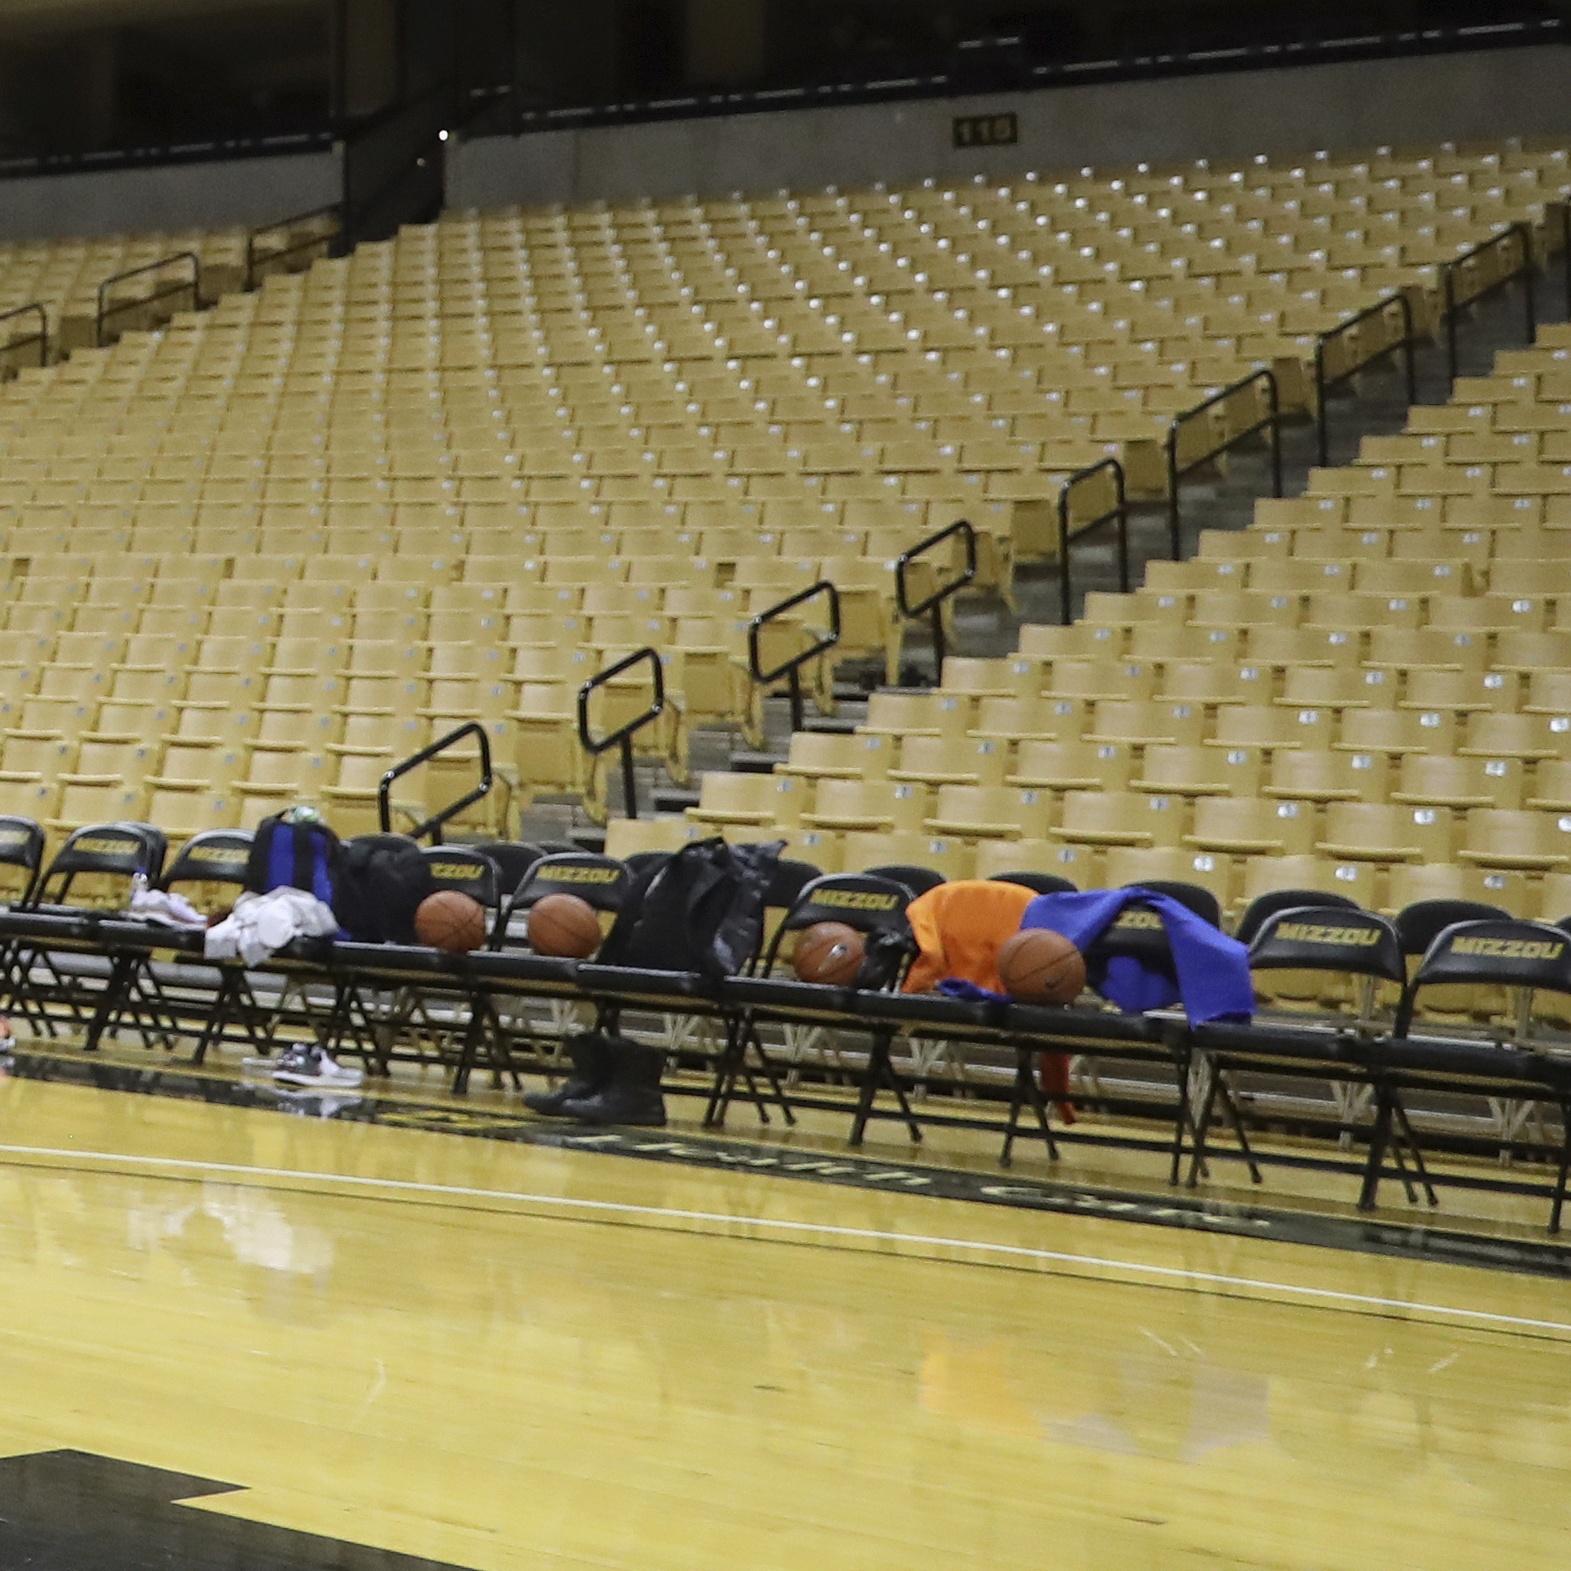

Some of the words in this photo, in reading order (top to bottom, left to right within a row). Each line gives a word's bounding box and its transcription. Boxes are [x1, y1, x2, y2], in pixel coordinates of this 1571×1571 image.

[810, 888, 900, 911] MIZZOU
[1274, 922, 1382, 947] MIZZOU
[1451, 936, 1565, 960] MIZZOU
